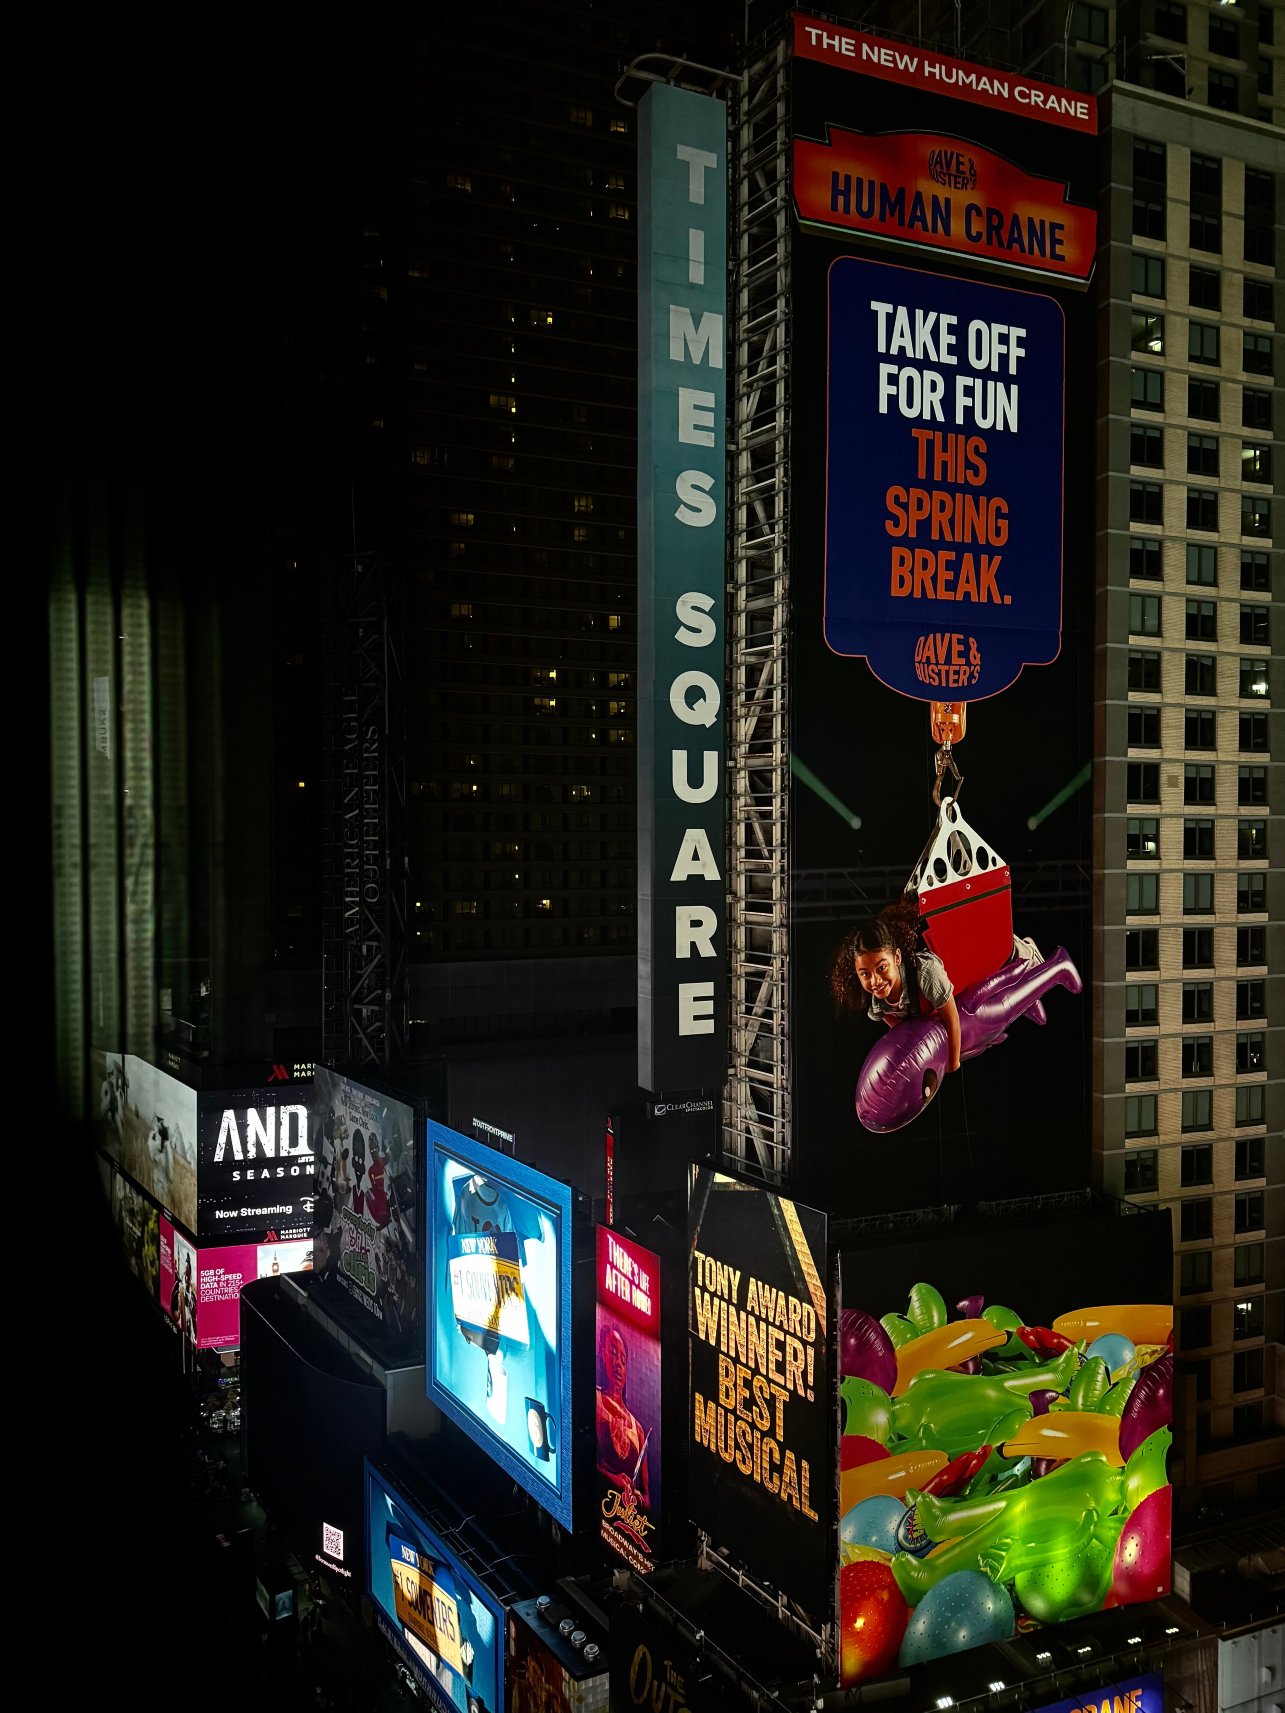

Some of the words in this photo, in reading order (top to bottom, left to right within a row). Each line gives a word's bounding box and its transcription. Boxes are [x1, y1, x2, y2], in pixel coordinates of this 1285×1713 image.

[805, 26, 856, 57] THE
[862, 42, 919, 73] NEW
[923, 60, 1009, 98] HUMAN
[1014, 85, 1090, 120] CRANE
[830, 170, 951, 237] HUMAN
[964, 202, 1066, 262] CRANE
[669, 143, 724, 528] TIMES
[871, 300, 958, 365] TAKE
[968, 319, 1027, 375] OFF
[879, 362, 945, 422] FOR
[955, 375, 1019, 433] FUN
[912, 428, 988, 487] THIS
[885, 485, 1009, 547] SPRING
[890, 546, 1012, 605] BREAK.
[915, 632, 964, 666] DAVE
[968, 637, 981, 667] &
[915, 660, 981, 688] BUSTER'S
[343, 684, 359, 776] EAGLE
[362, 724, 379, 904] OUTFITTERS
[668, 591, 722, 1037] SQUARE
[343, 785, 360, 944] AMERICAN
[232, 1165, 315, 1181] SEASON
[215, 1210, 238, 1219] Now
[240, 1204, 292, 1218] Streaming
[280, 1227, 311, 1235] MARRIOTT
[215, 1268, 225, 1276] OF
[460, 1238, 476, 1253] NEW
[476, 1236, 498, 1254] YORK
[200, 1273, 242, 1283] HIGH-SPEED
[200, 1287, 239, 1296] COUNTRIES
[228, 1279, 244, 1287] 215+
[605, 1263, 631, 1303] AFTER
[695, 1250, 741, 1298] TONY
[747, 1276, 816, 1343] AWARD
[695, 1286, 815, 1402] WINNER!
[718, 1353, 789, 1443] BEST
[695, 1392, 819, 1522] MUSICAL
[401, 1544, 415, 1565] NEW
[600, 1529, 628, 1559] MUSICAL
[601, 1518, 644, 1562] BROADWAY'S
[663, 1658, 687, 1695] THE
